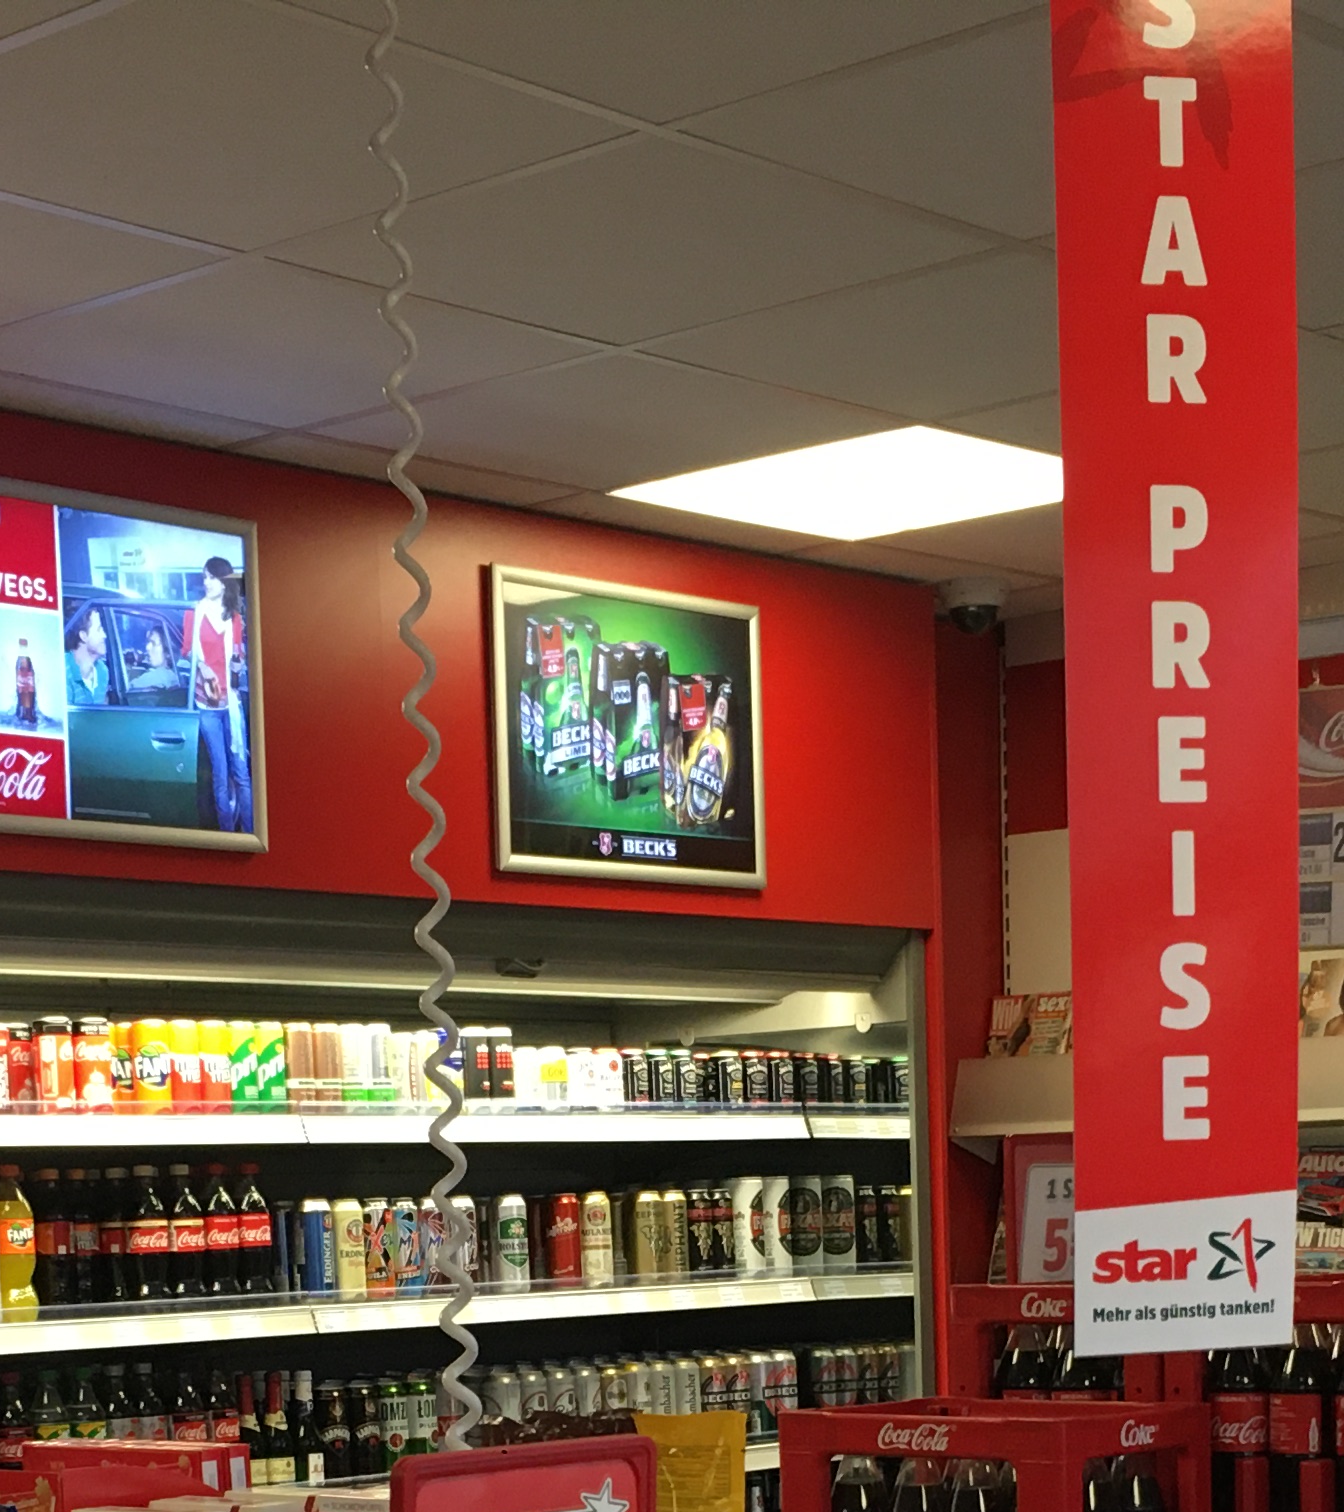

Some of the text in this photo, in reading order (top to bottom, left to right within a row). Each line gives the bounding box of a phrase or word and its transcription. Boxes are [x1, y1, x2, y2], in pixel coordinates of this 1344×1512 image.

[1149, 484, 1212, 1142] PREISE
[622, 838, 677, 857] BECK'S
[1092, 1238, 1197, 1284] star
[1021, 1292, 1068, 1318] Coke
[1092, 1299, 1276, 1323] Mehr als günstig tanken!
[877, 1421, 950, 1453] Coca-Cola
[1120, 1418, 1156, 1448] Coke
